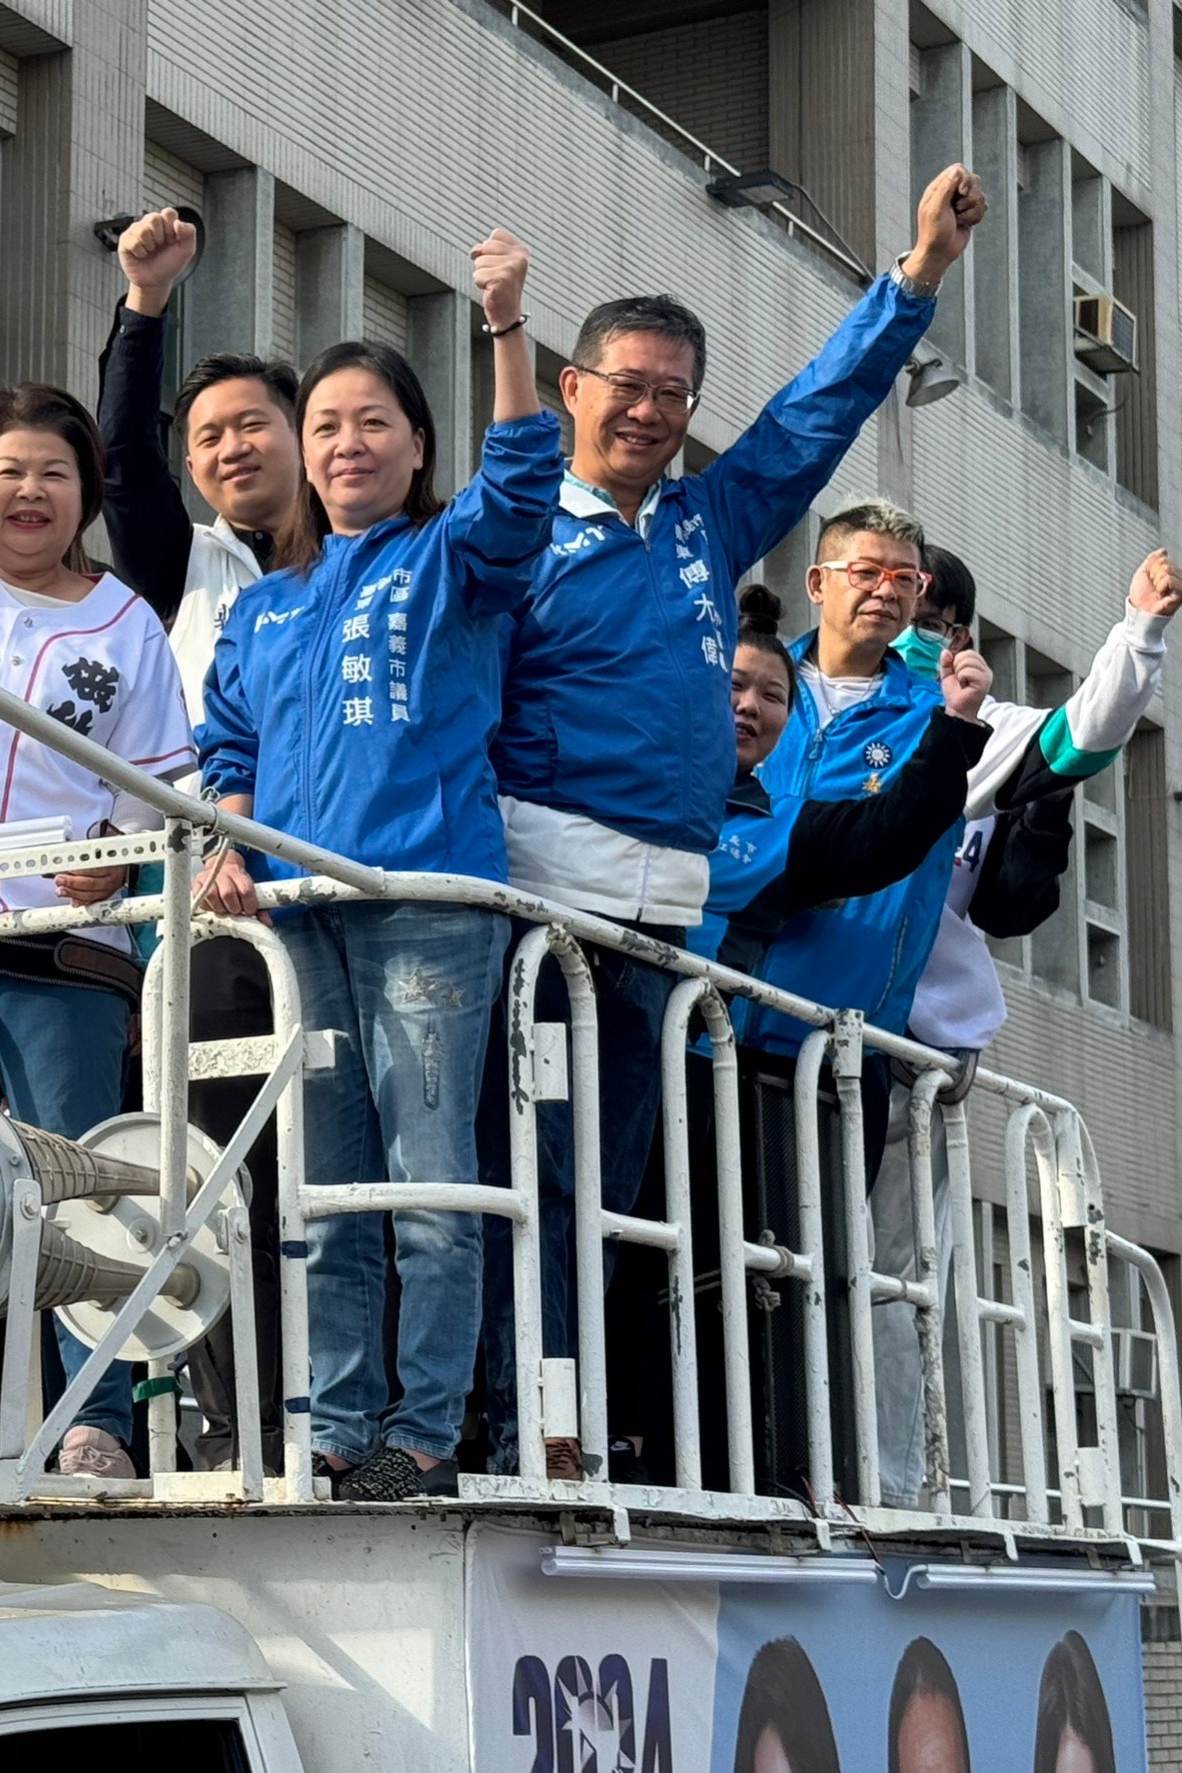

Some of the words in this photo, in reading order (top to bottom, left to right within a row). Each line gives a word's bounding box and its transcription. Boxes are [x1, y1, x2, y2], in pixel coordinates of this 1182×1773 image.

[341, 613, 375, 727] 張敏琪
[387, 612, 411, 723] 嘉義市議員
